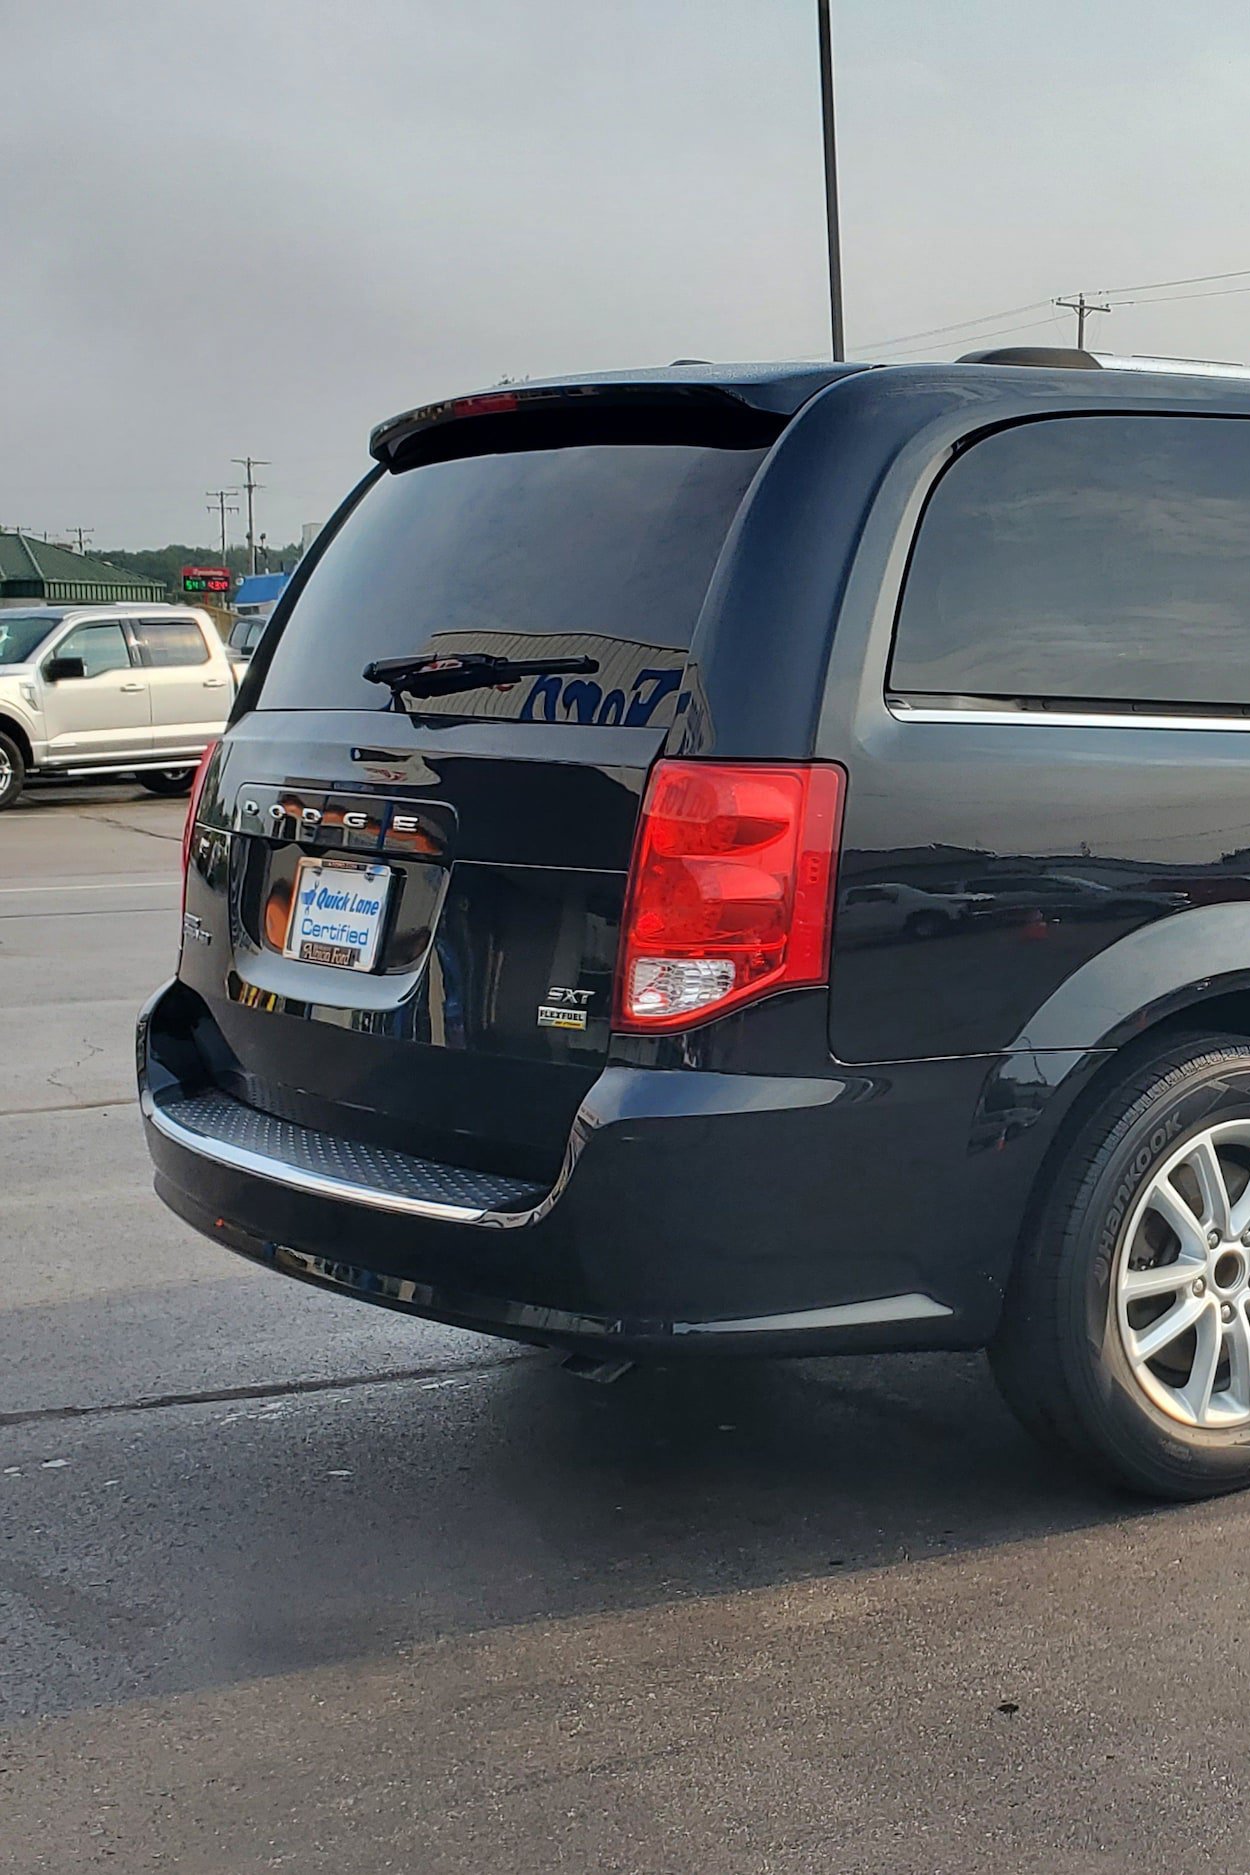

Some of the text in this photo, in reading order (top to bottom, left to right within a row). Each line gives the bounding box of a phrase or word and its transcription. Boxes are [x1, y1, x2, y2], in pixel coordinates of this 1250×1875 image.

[245, 800, 419, 833] DODGE
[316, 887, 380, 916] Quick Lane
[301, 918, 370, 946] Certified
[331, 947, 352, 966] Ford
[547, 987, 596, 1005] SXT
